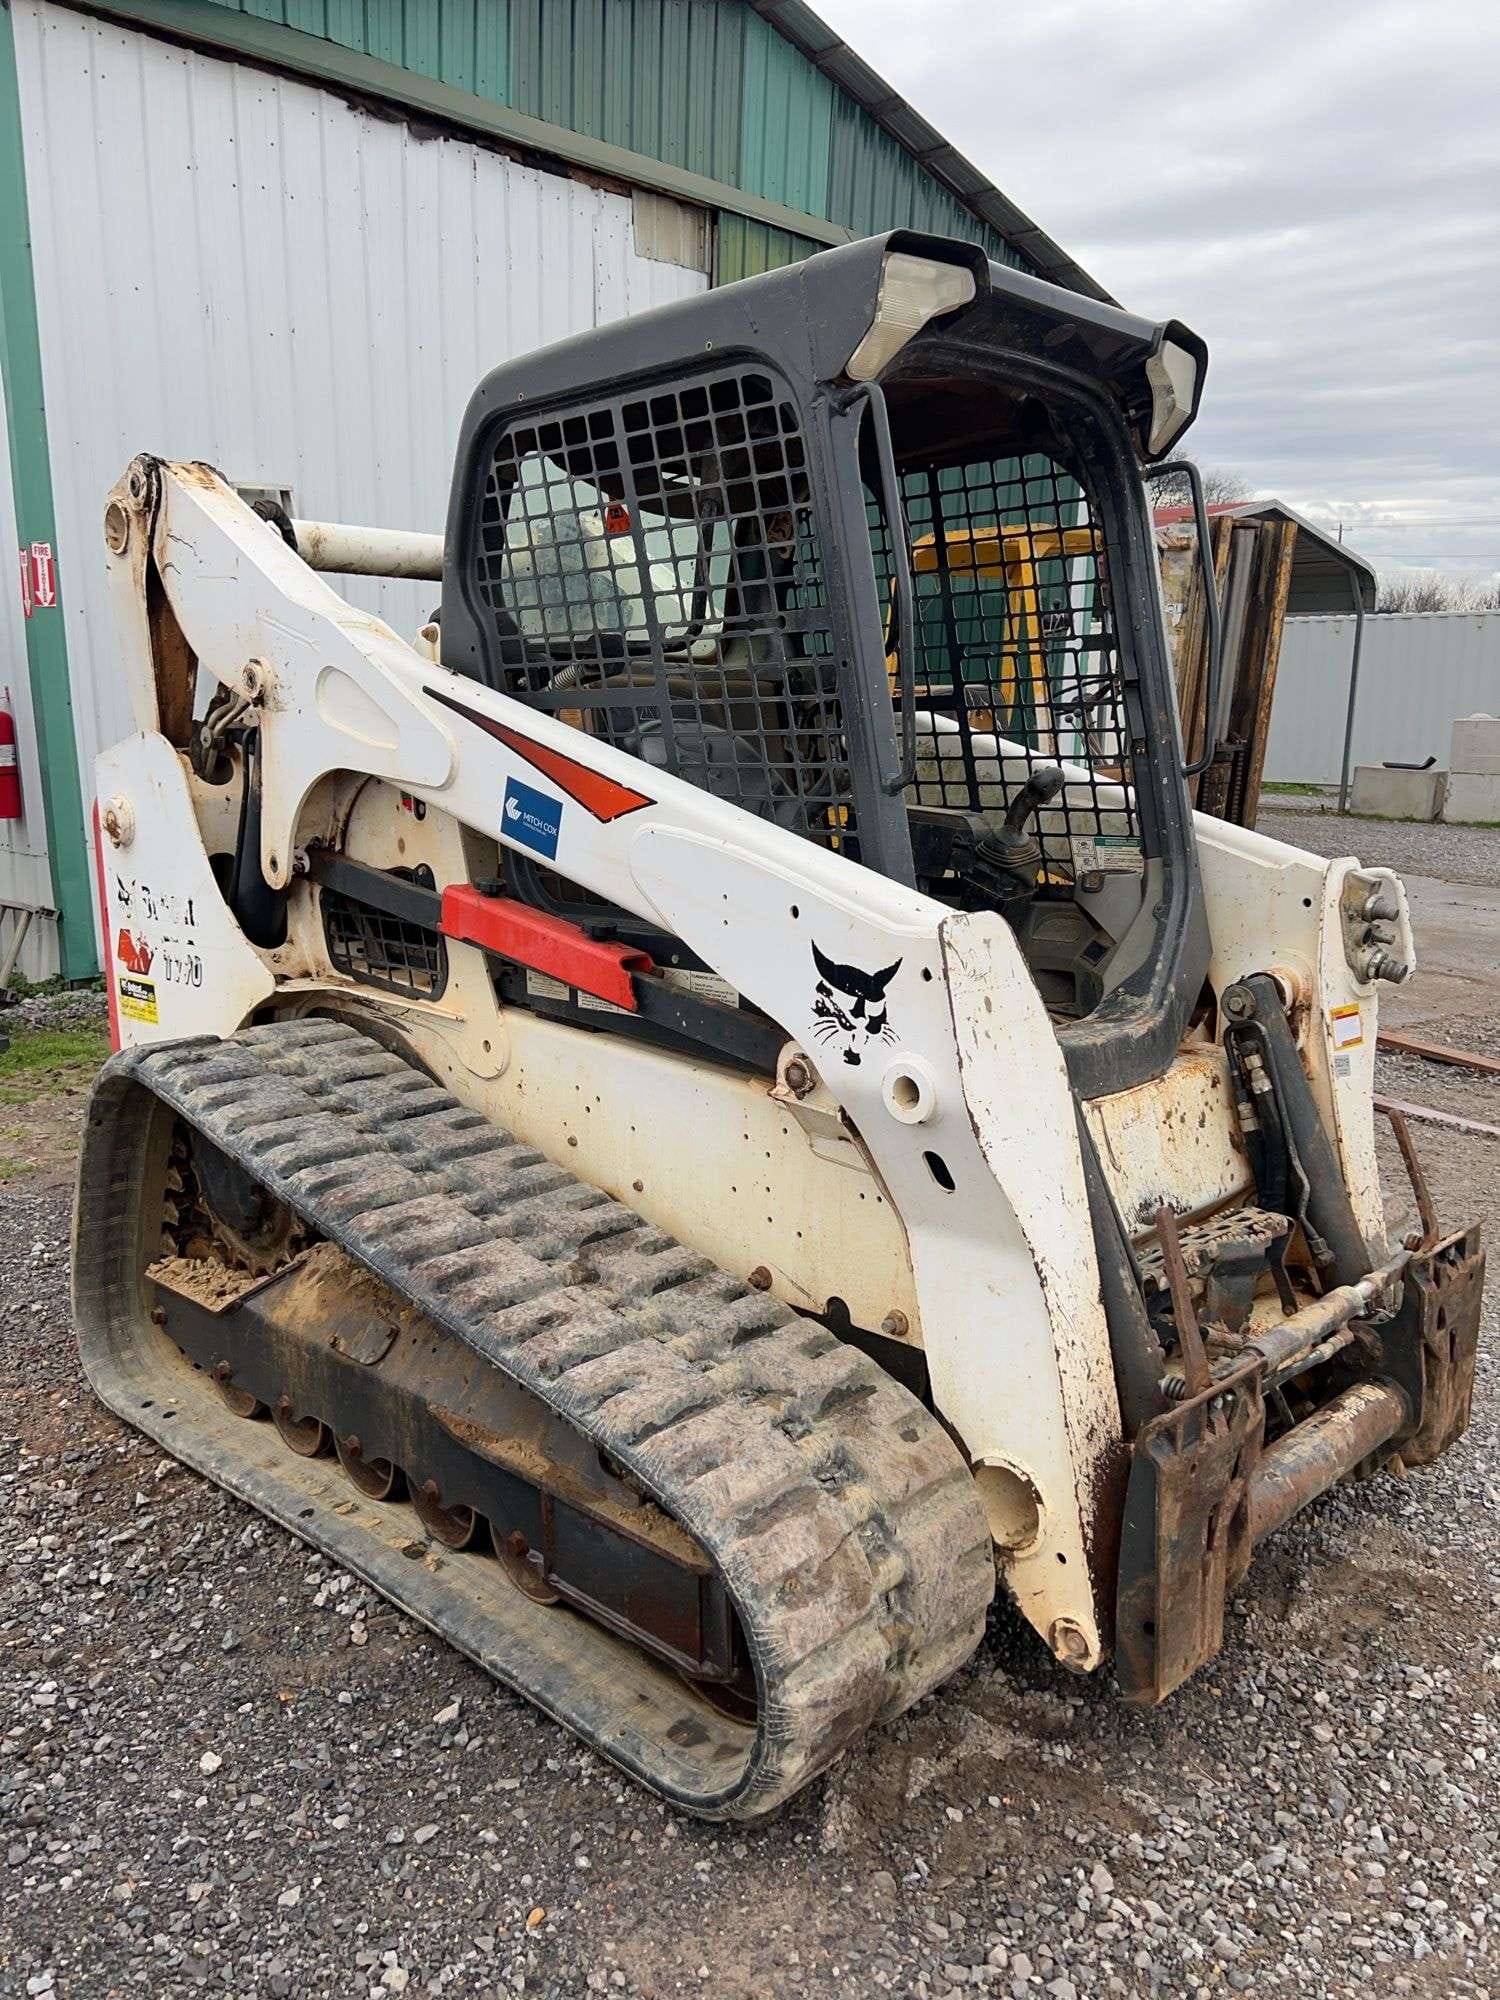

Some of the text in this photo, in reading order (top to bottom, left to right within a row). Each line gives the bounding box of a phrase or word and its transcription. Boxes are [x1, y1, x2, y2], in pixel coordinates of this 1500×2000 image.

[34, 546, 49, 557] FIRE
[523, 812, 543, 828] MITCH
[543, 822, 558, 836] COX
